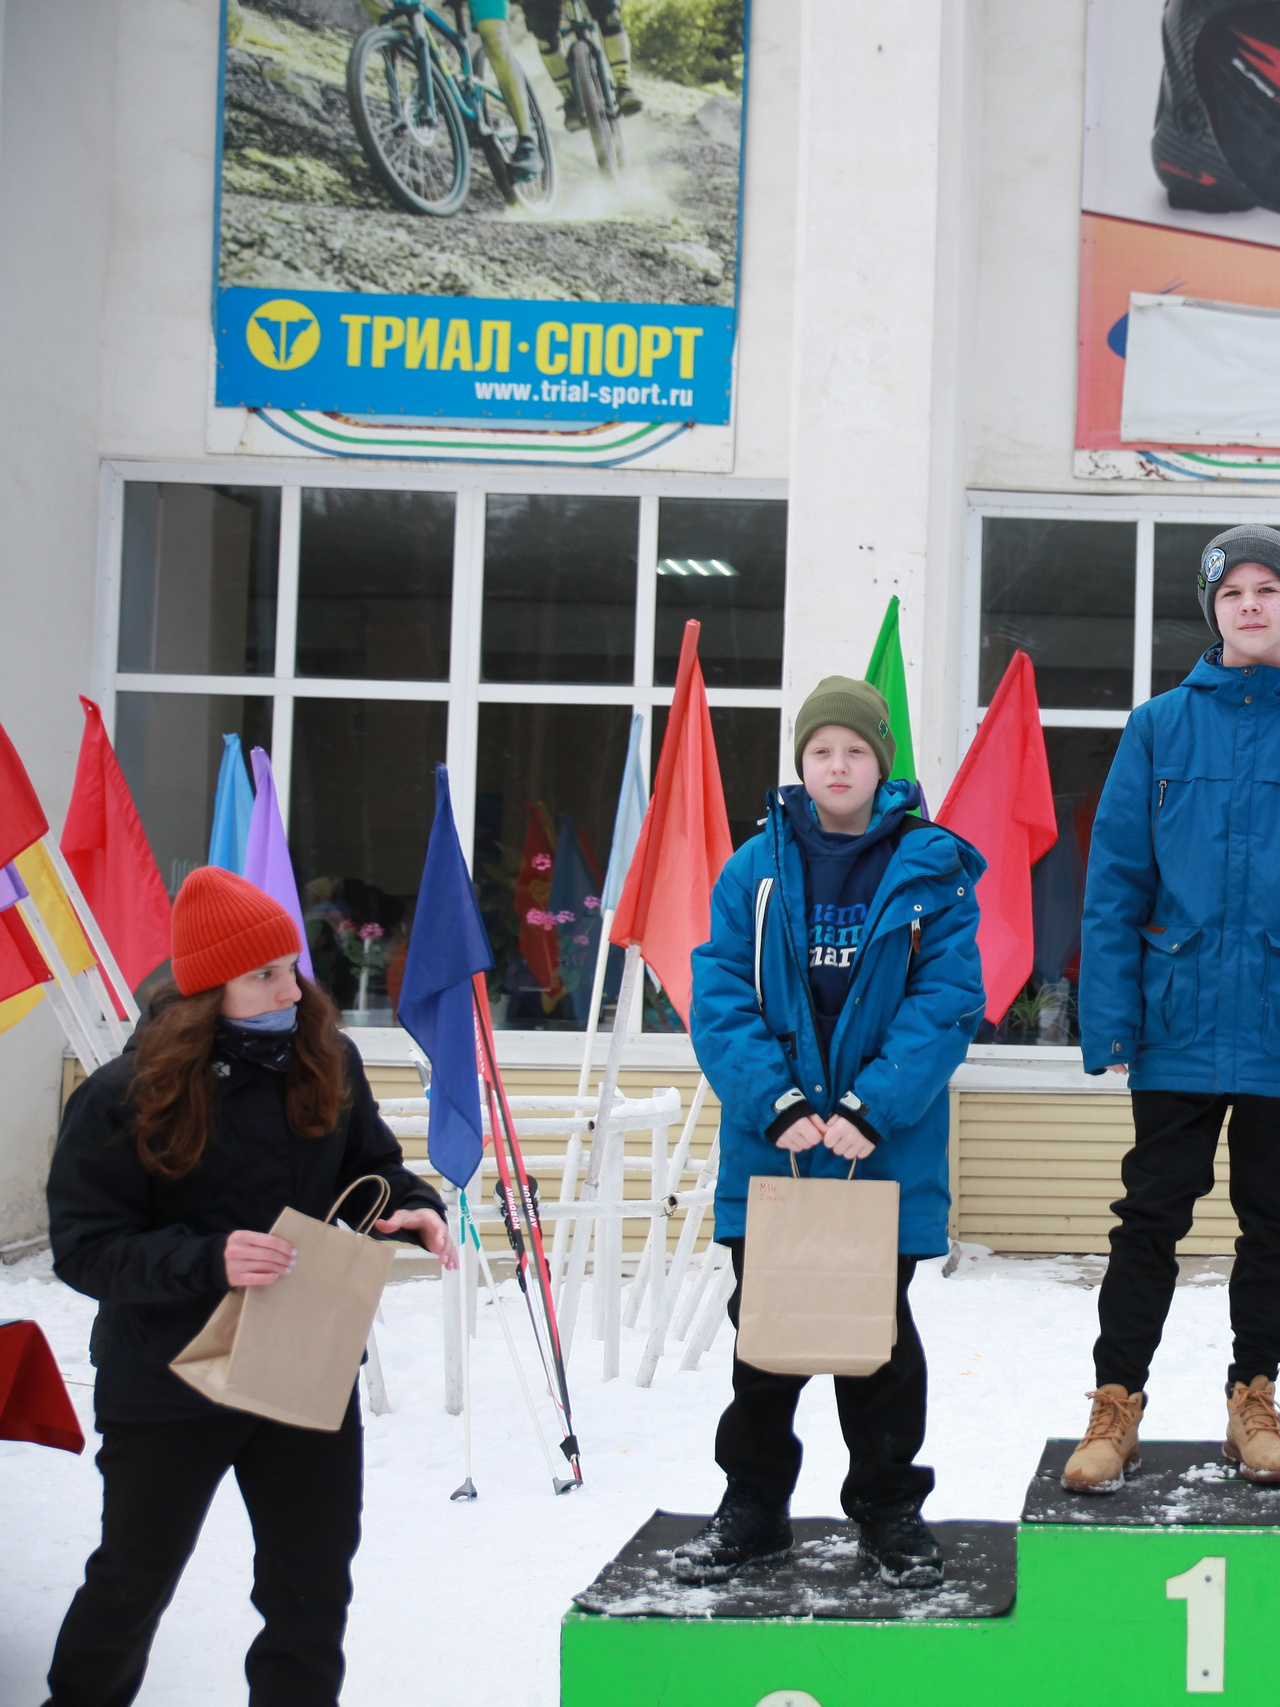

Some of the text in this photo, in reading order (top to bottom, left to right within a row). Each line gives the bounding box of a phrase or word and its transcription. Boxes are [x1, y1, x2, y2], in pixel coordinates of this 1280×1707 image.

[474, 381, 694, 408] www.trial-sport.ru
[505, 1186, 521, 1230] NORDWAY
[522, 1185, 538, 1228] NORDWAY
[1166, 1556, 1226, 1692] 1
